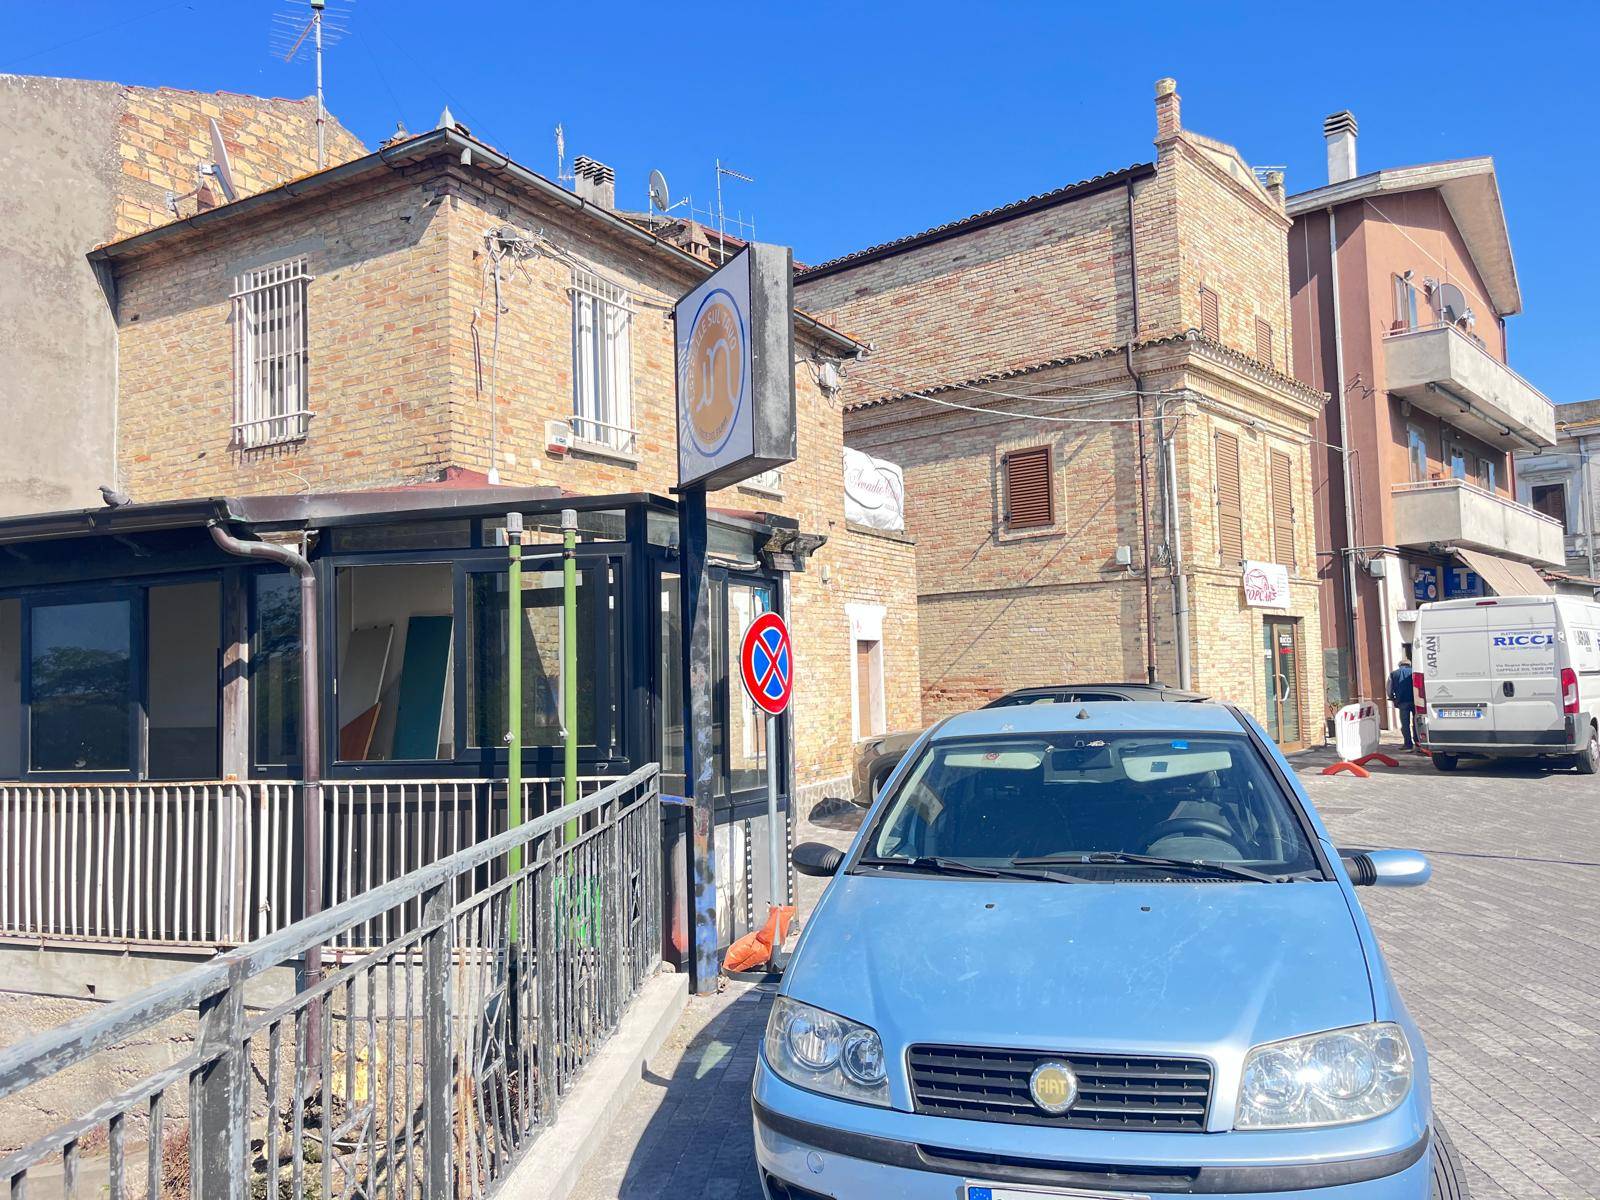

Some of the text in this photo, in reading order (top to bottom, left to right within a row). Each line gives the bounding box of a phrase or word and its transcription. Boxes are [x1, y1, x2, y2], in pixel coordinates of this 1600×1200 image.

[1453, 568, 1474, 589] T
[1493, 635, 1553, 646] RICCI
[1426, 636, 1437, 668] ARAN
[1037, 1078, 1066, 1095] FIAT
